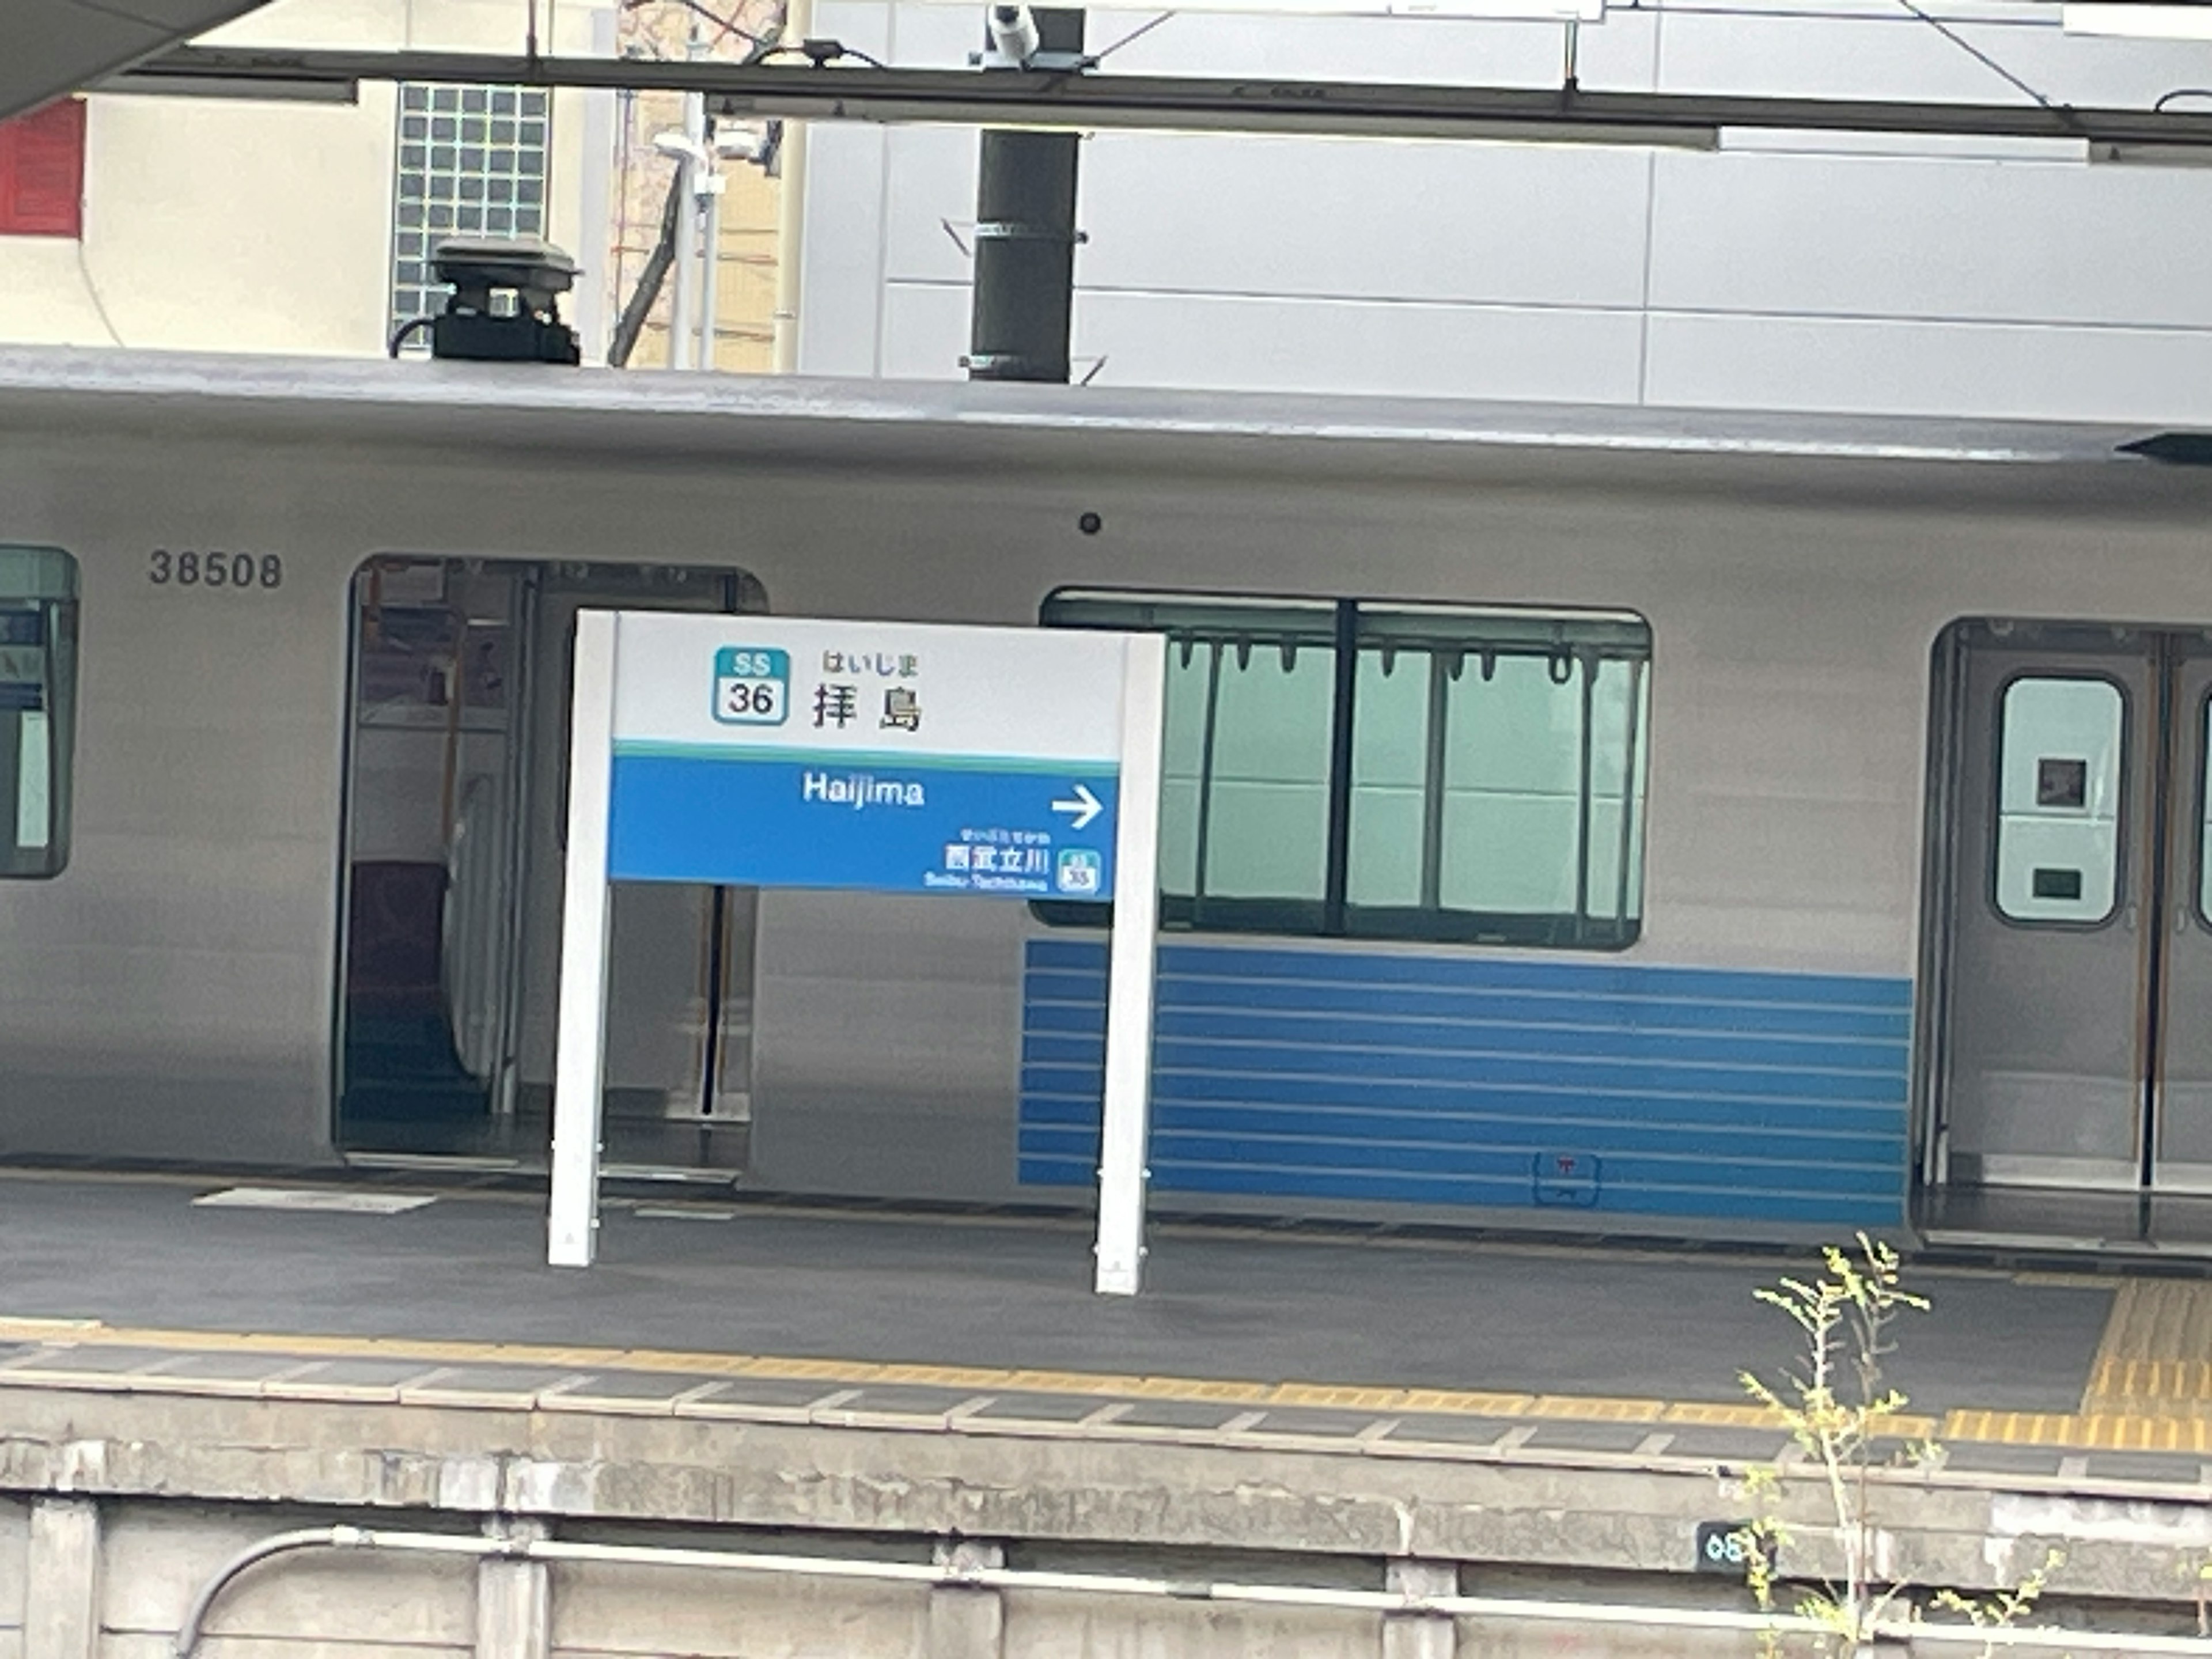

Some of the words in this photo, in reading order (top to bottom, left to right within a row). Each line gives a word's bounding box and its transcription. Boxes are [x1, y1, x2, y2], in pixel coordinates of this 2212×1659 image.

[150, 550, 281, 588] 38508
[733, 653, 771, 676] SS
[823, 650, 918, 677] はいじま
[729, 683, 773, 714] 36
[813, 683, 921, 732] 拝島
[803, 771, 925, 810] Haijima
